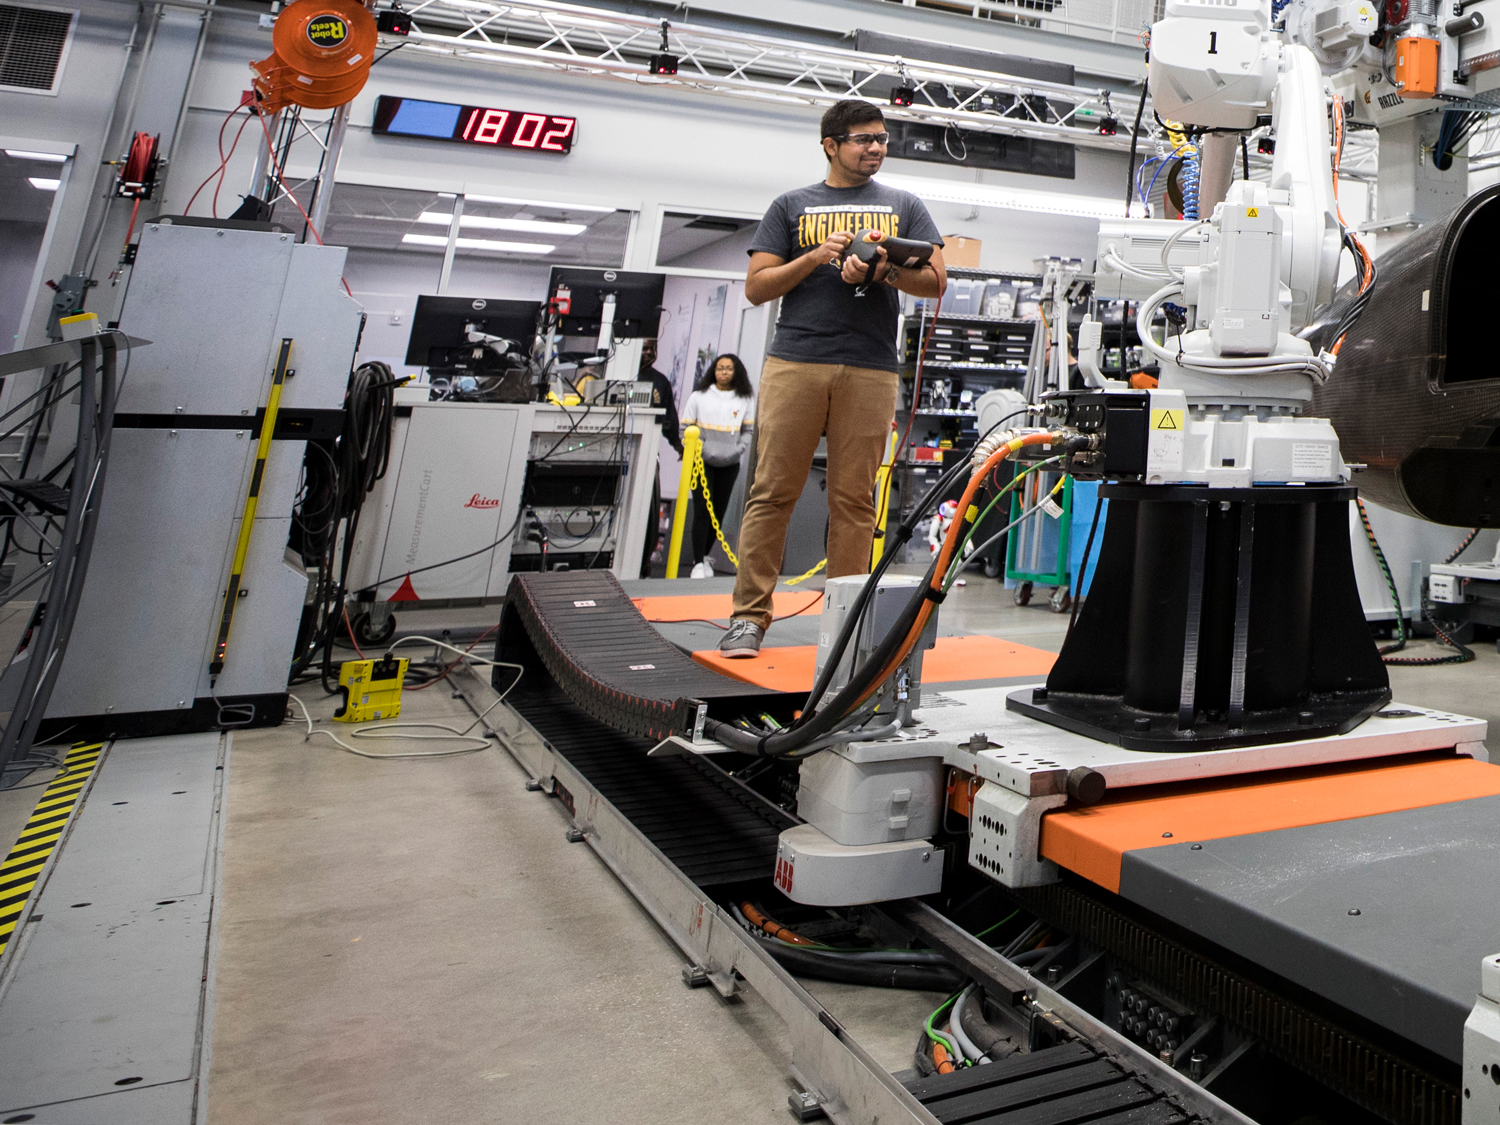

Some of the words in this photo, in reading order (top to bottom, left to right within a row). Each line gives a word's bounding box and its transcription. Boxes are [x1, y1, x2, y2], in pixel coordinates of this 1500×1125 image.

[1208, 31, 1217, 54] 1
[1378, 92, 1404, 109] RAZZLE
[464, 493, 499, 509] Leica
[406, 469, 432, 565] MeasurementCart
[827, 593, 831, 609] 1
[775, 857, 794, 893] ABB
